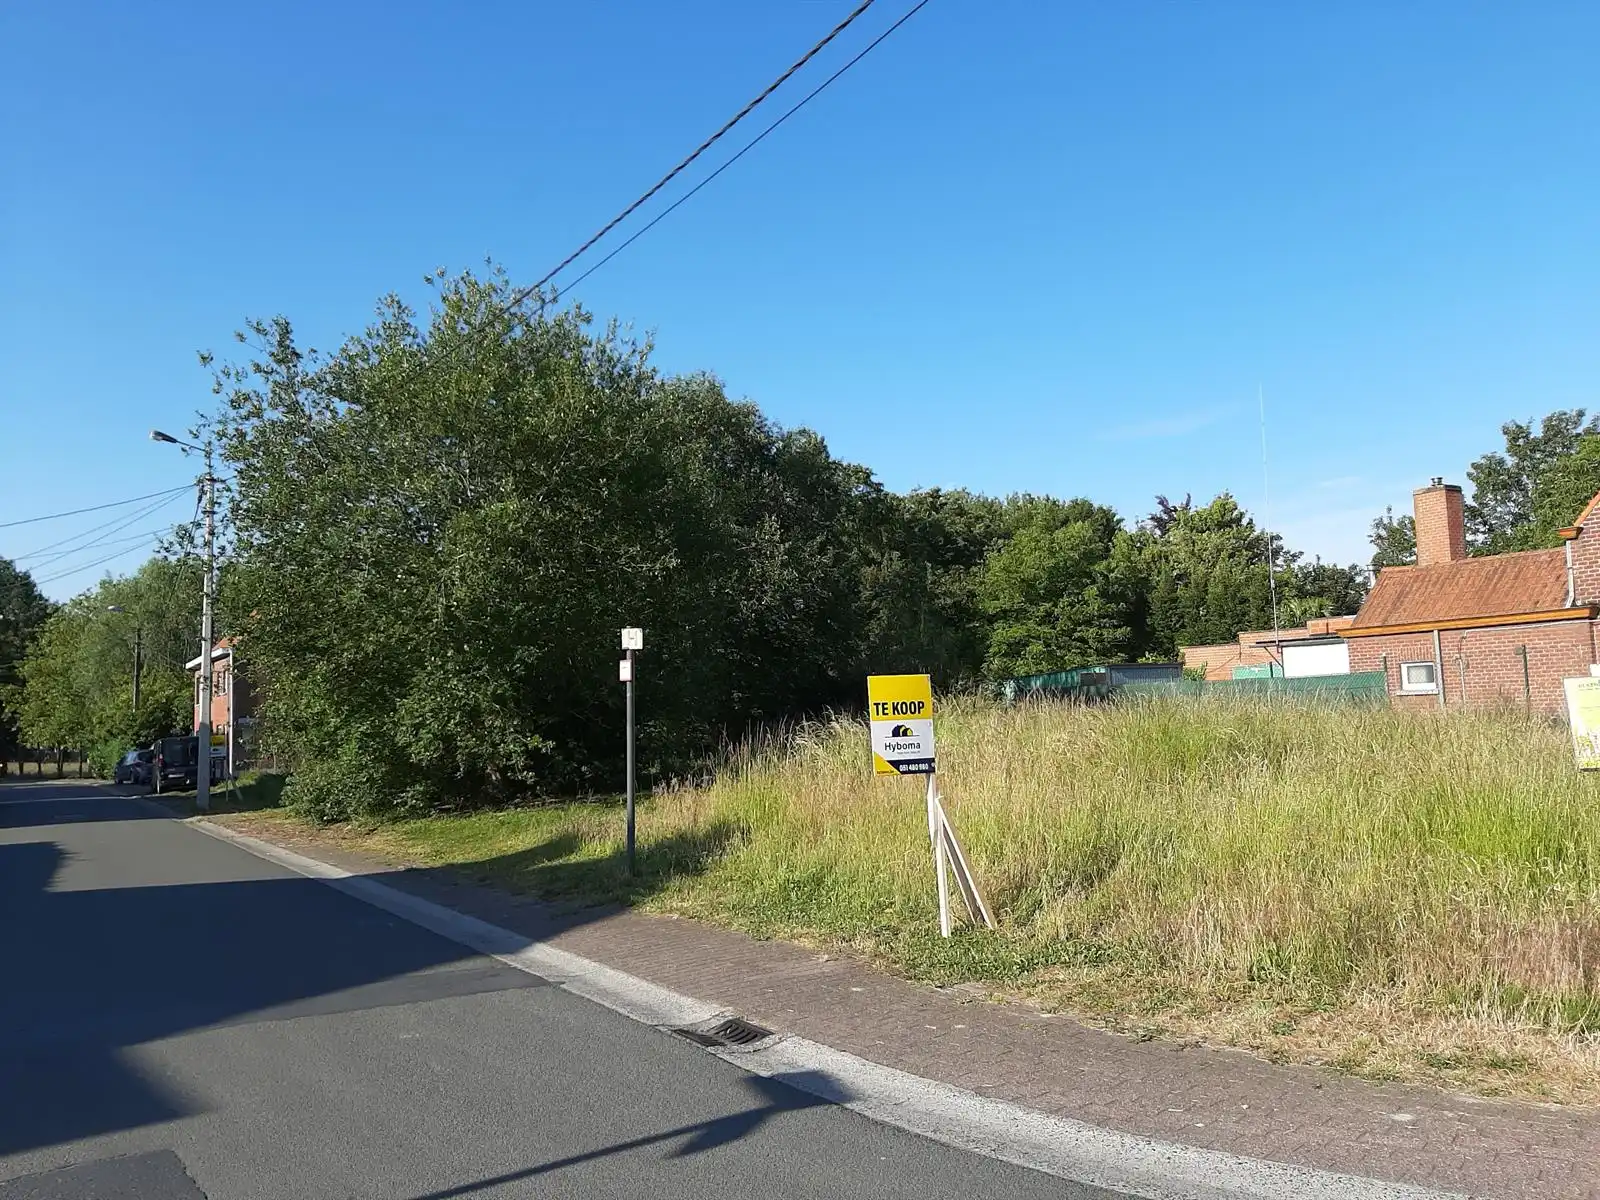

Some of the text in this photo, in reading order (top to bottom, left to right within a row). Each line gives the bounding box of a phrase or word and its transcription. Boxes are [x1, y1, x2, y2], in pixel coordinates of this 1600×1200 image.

[873, 701, 925, 716] TE KOOP
[884, 742, 921, 752] Hyboma
